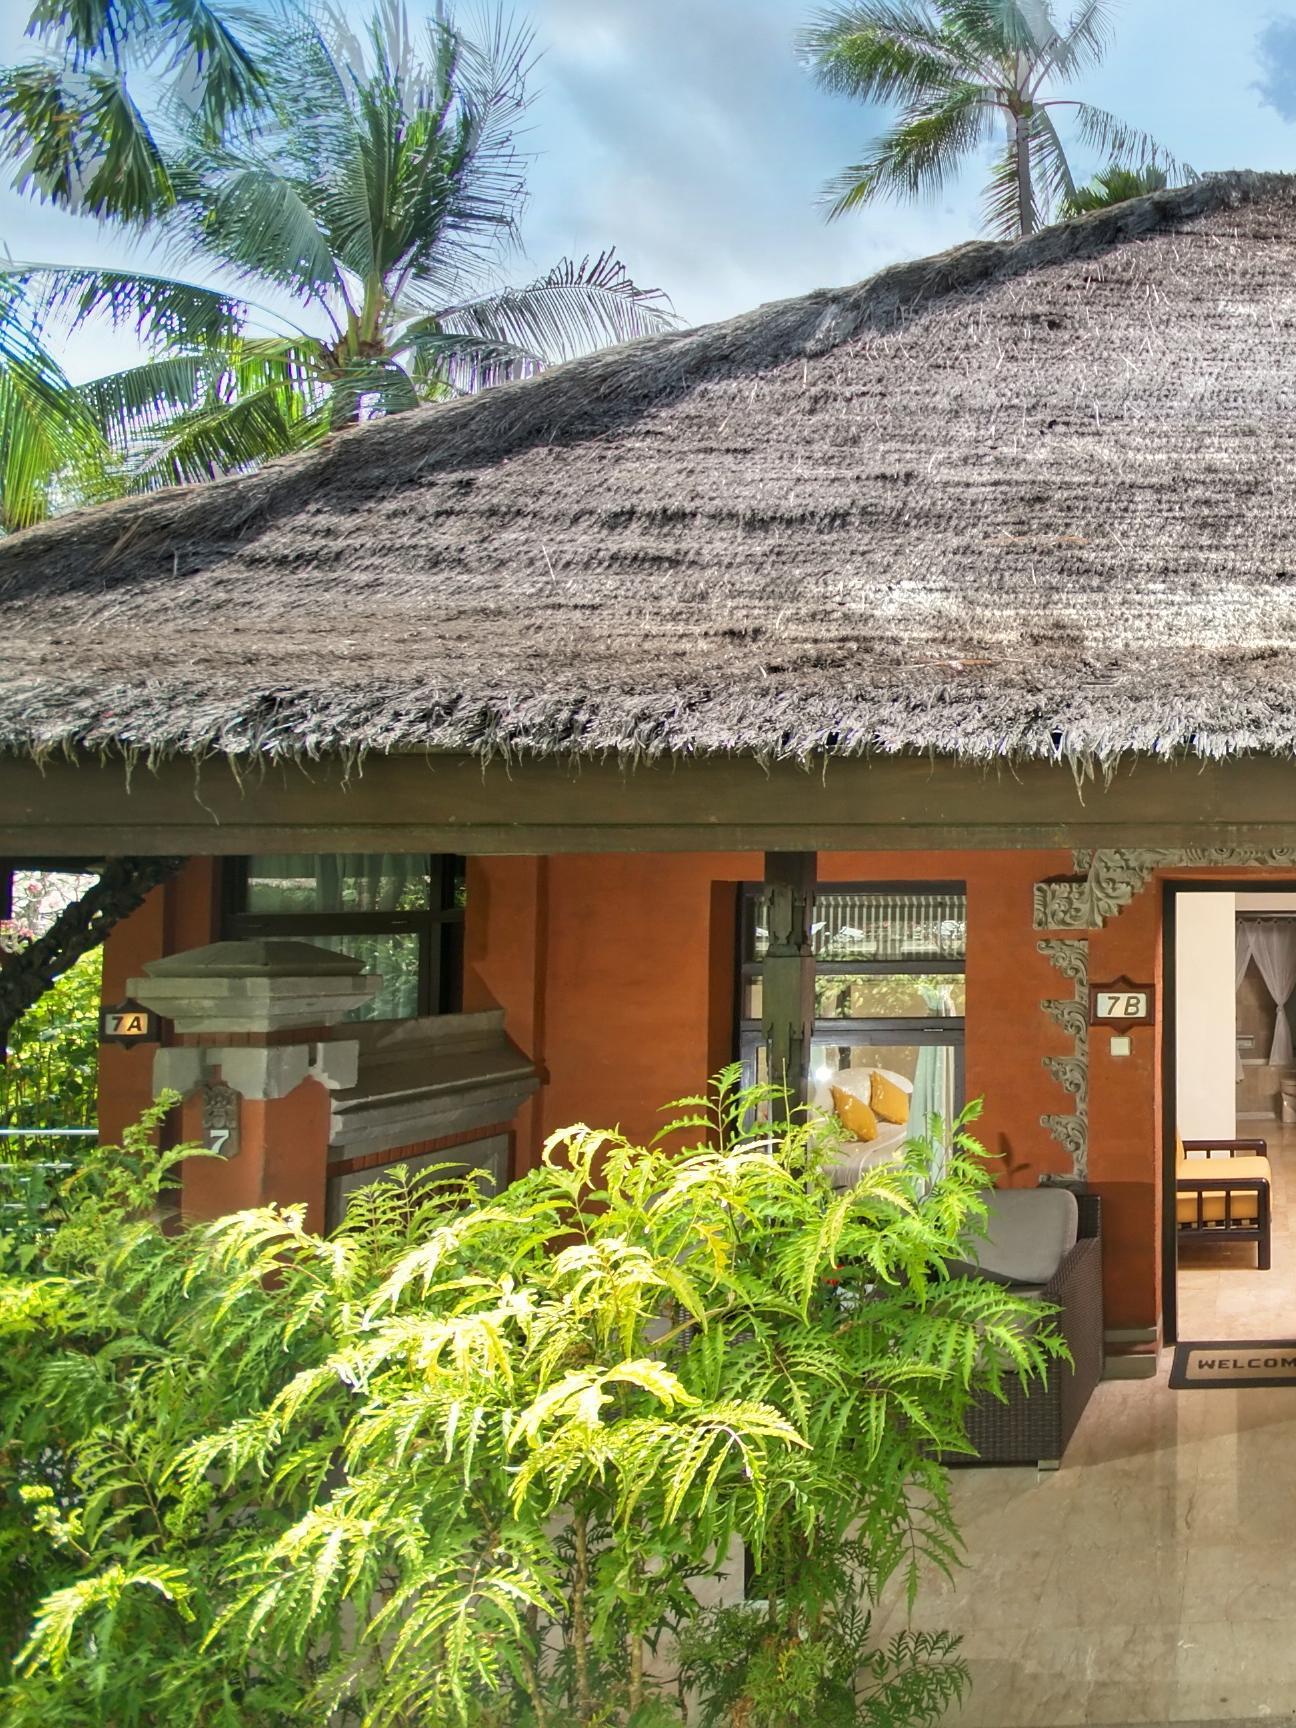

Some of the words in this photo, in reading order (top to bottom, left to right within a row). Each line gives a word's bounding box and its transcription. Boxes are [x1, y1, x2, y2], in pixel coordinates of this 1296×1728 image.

[1107, 995, 1141, 1016] 7B
[111, 1015, 143, 1032] 7A
[209, 1129, 229, 1154] 7
